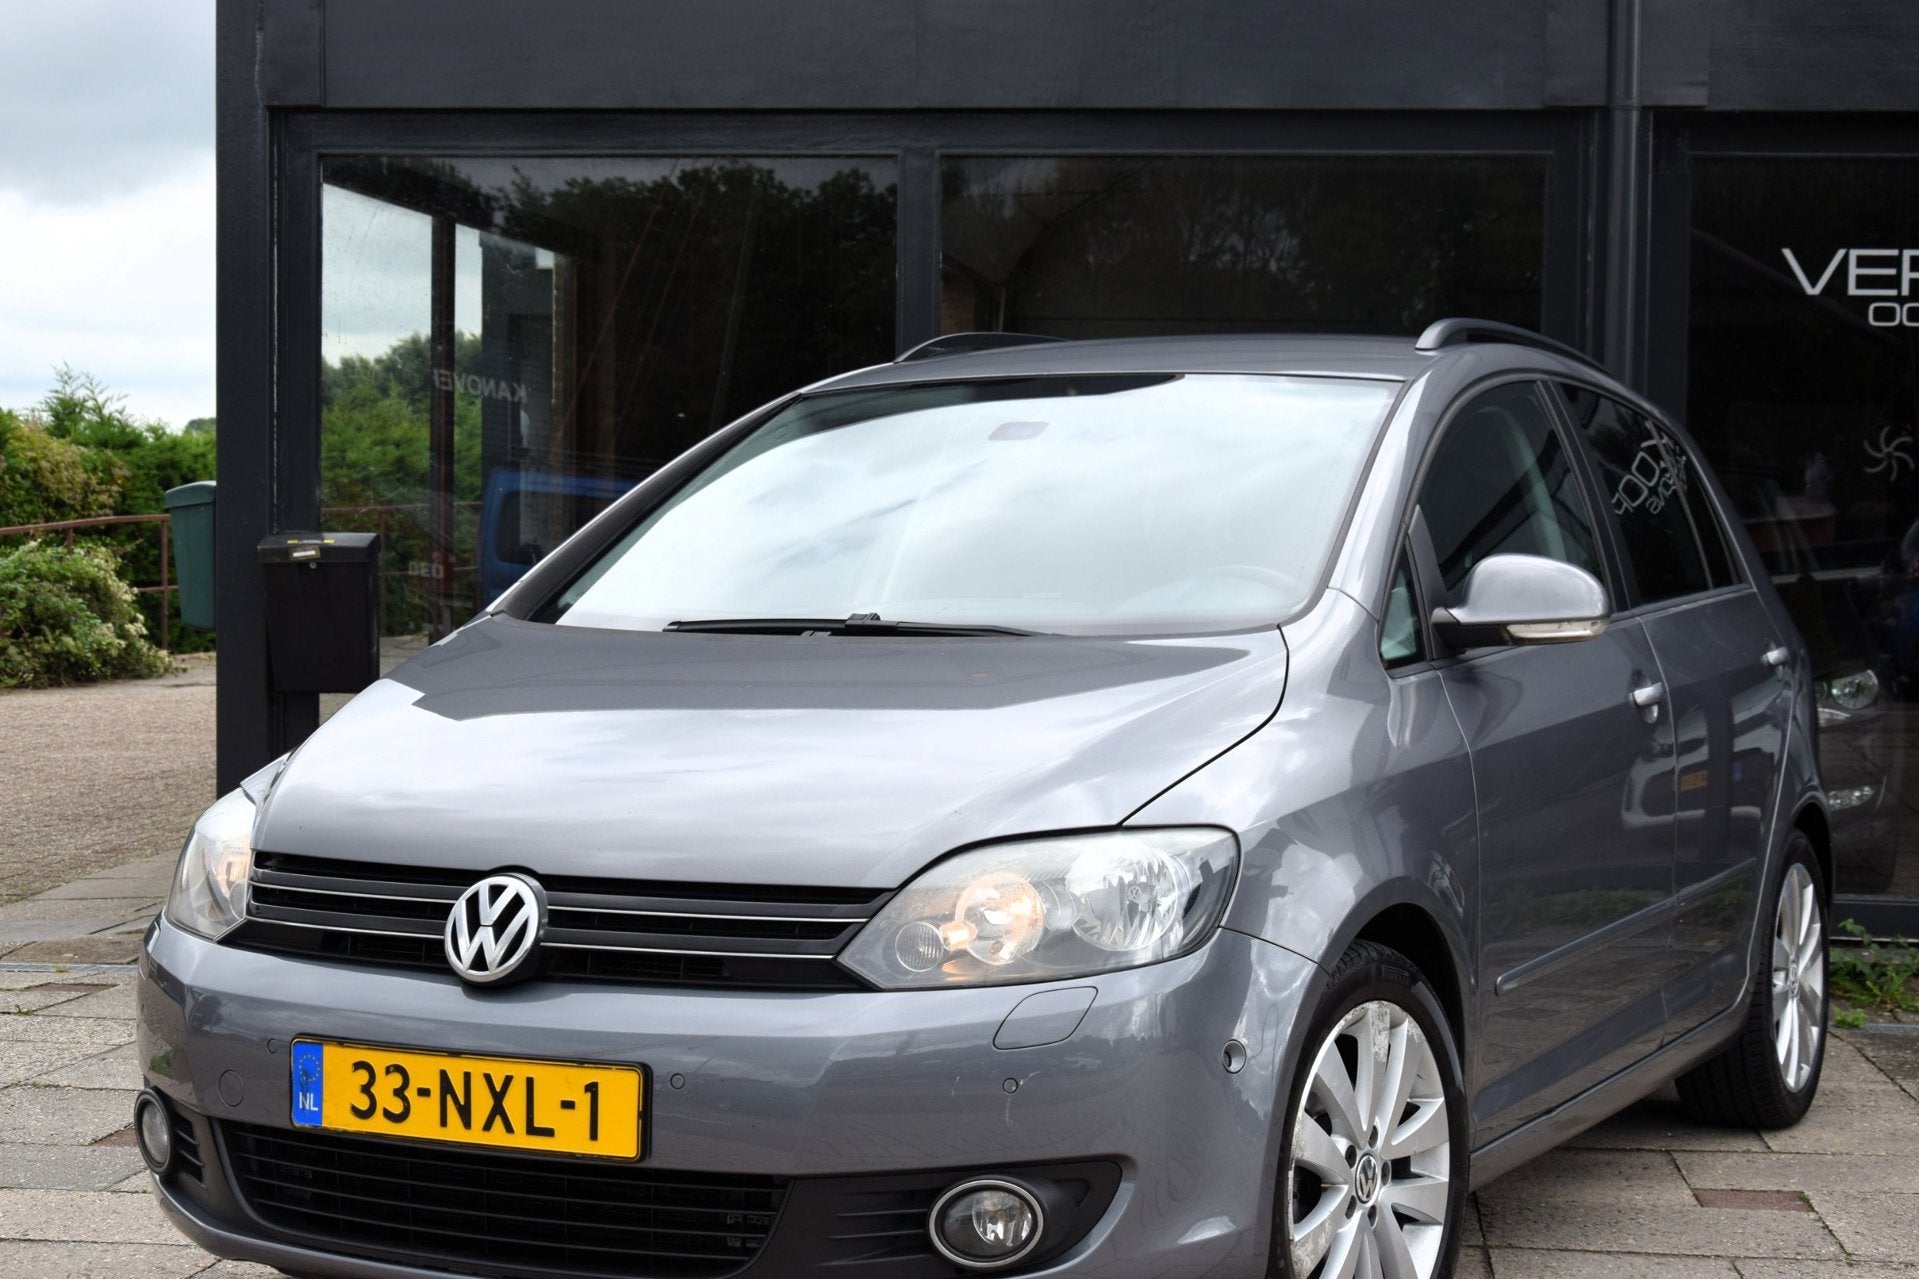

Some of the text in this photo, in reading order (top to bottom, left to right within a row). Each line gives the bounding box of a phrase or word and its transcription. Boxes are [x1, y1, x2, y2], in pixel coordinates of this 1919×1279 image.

[446, 876, 538, 980] VW
[299, 1091, 319, 1111] NL
[350, 1060, 599, 1141] 33-NXL-1
